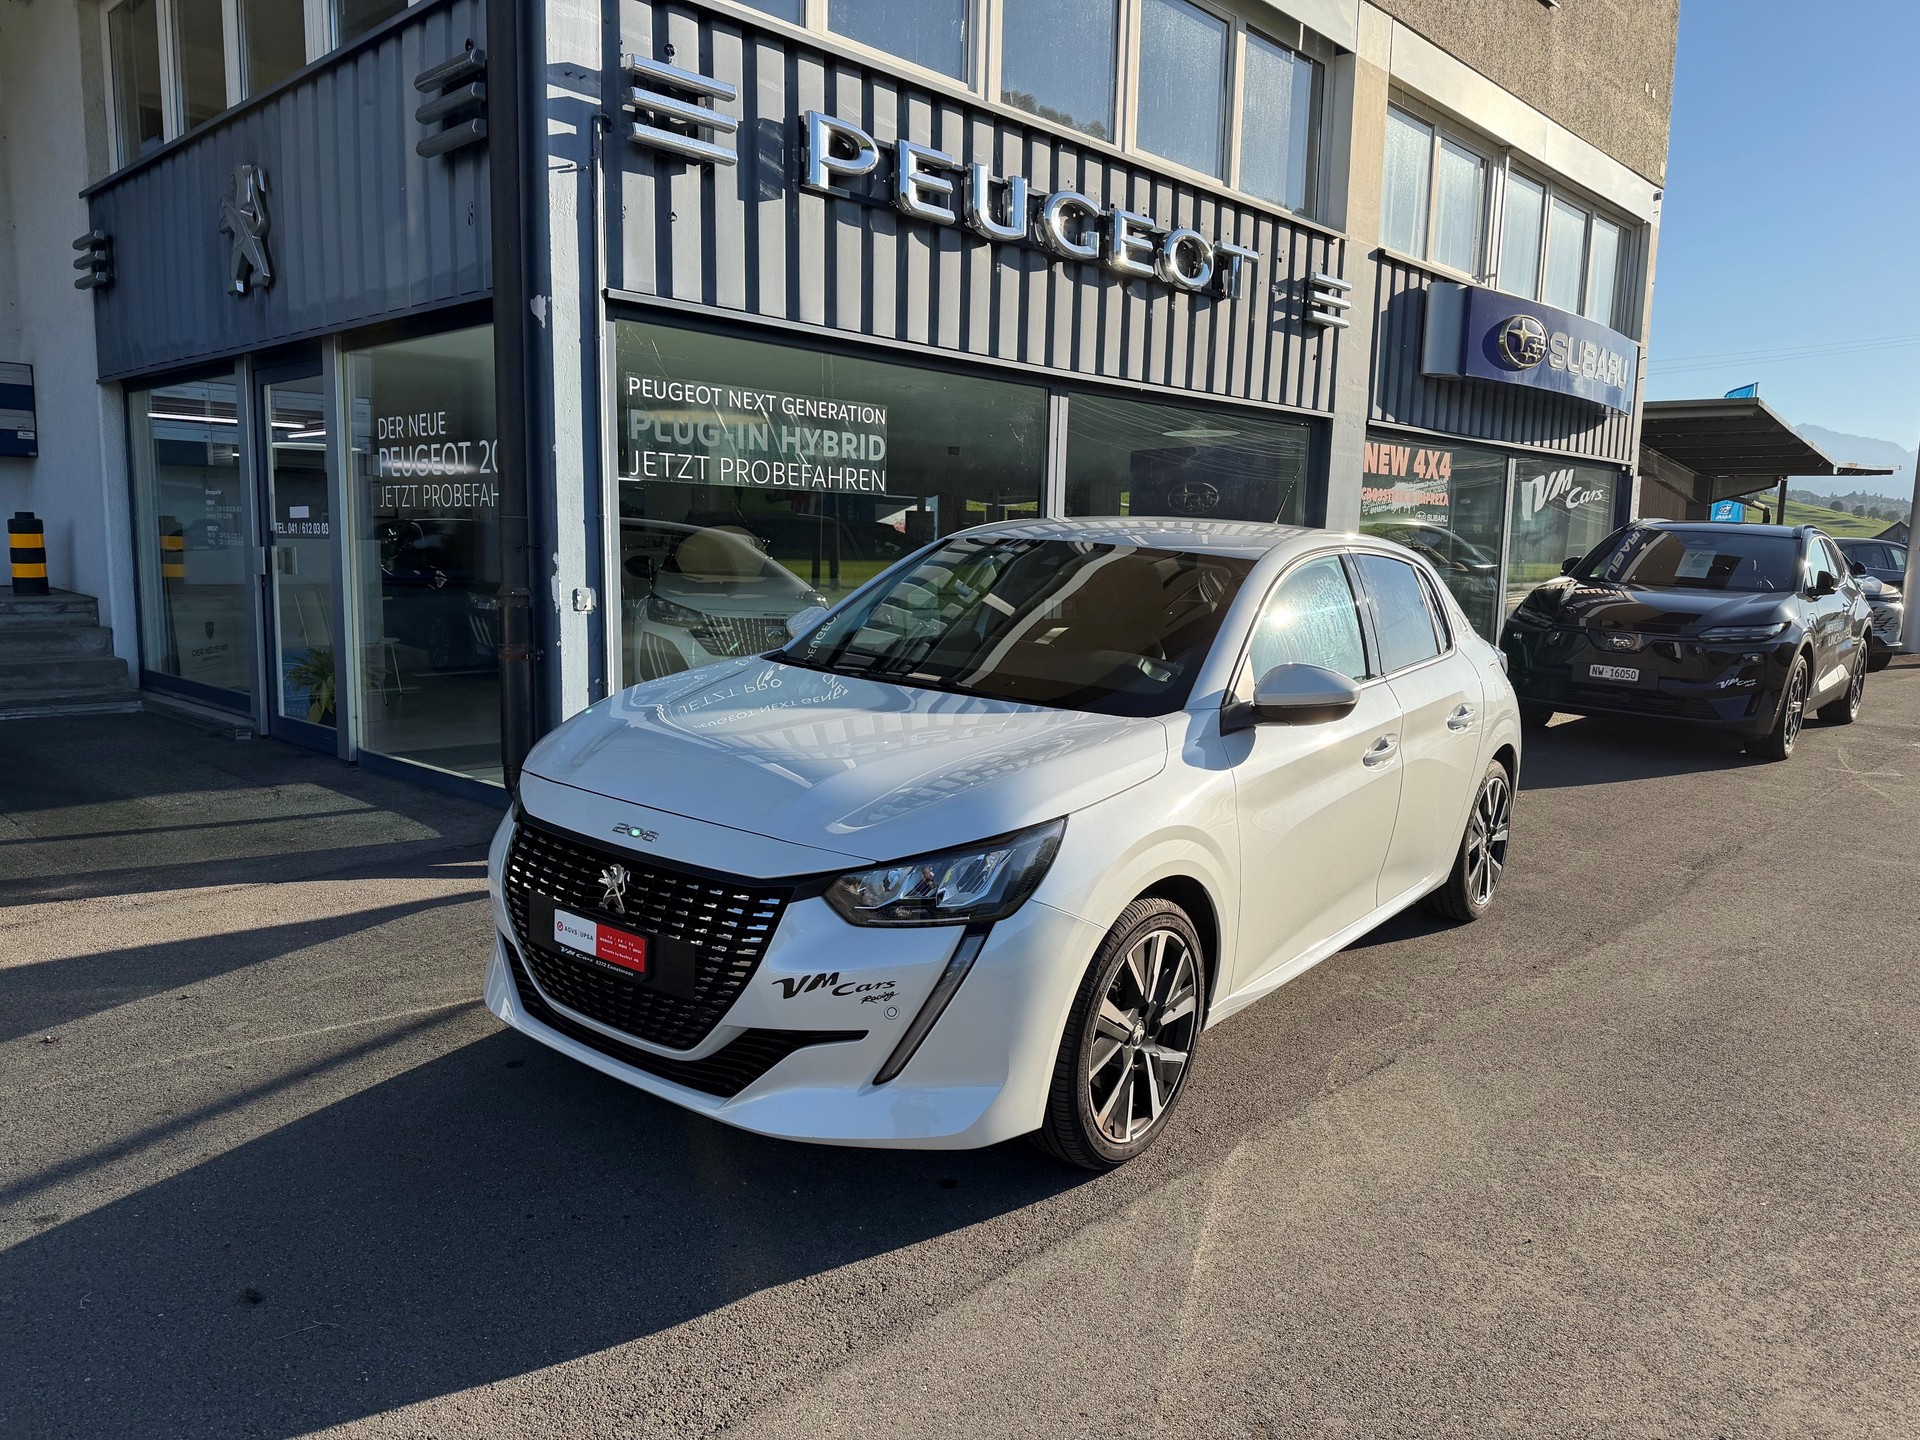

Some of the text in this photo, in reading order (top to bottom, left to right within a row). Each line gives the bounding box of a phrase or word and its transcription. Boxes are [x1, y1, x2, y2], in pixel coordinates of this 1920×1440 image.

[803, 110, 1259, 300] PEUGEOT
[1549, 332, 1629, 390] SUBARU
[628, 376, 887, 425] PEUGEOT NEXT GENERATION
[377, 411, 447, 440] DER NEUE
[629, 408, 886, 462] PLUG-IN HYBRID
[378, 441, 472, 478] PEUGEOT
[629, 449, 886, 492] JETZT PROBEFAHREN
[1363, 441, 1451, 481] NEW 4X4
[379, 484, 419, 508] JETZT
[1565, 486, 1605, 509] Cars
[275, 522, 288, 534] TEL.
[288, 522, 298, 534] 041
[302, 522, 312, 534] 612
[312, 522, 321, 534] 03
[321, 522, 329, 535] 03
[1426, 514, 1449, 523] SUBARU
[1591, 665, 1637, 680] NW 16050
[611, 822, 660, 843] 208
[771, 971, 897, 999] VM Cars
[860, 990, 901, 1005] Racing
